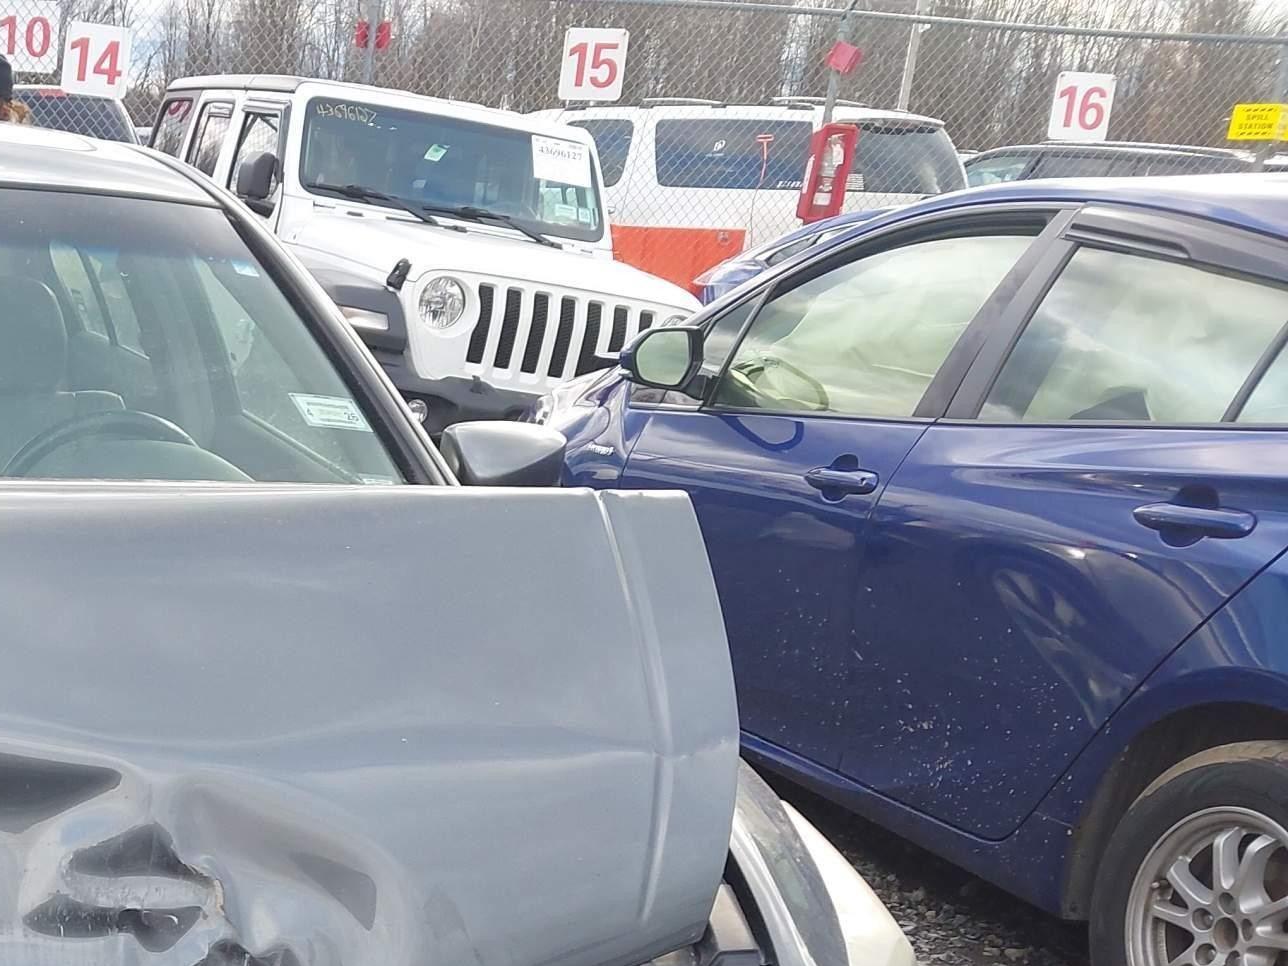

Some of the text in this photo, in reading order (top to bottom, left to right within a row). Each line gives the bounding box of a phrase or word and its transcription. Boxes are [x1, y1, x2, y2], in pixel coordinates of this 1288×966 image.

[0, 15, 51, 57] 10
[70, 37, 122, 85] 14
[569, 42, 619, 88] 15
[1059, 85, 1107, 130] 16
